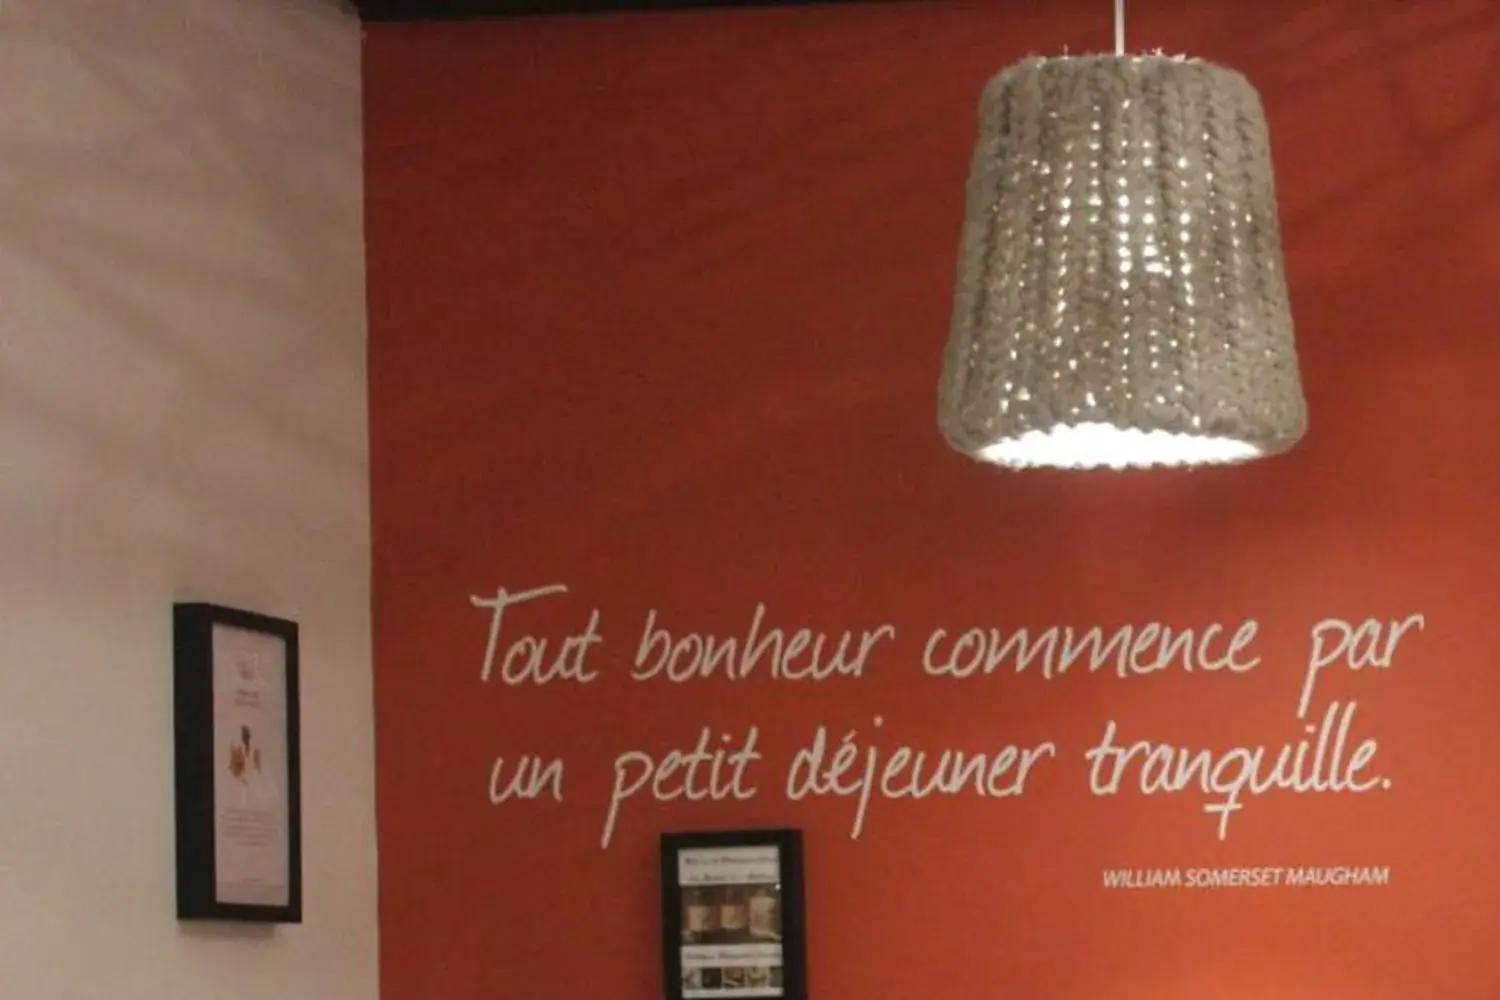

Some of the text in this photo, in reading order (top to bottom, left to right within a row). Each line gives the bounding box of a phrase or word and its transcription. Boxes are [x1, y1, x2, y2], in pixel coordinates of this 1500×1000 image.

[470, 583, 1424, 718] Tout bonheur commence par
[489, 701, 1393, 850] un petit déjeuner tranquille.
[1102, 866, 1391, 888] WILLIAM SOMERSET MAUGHAM
